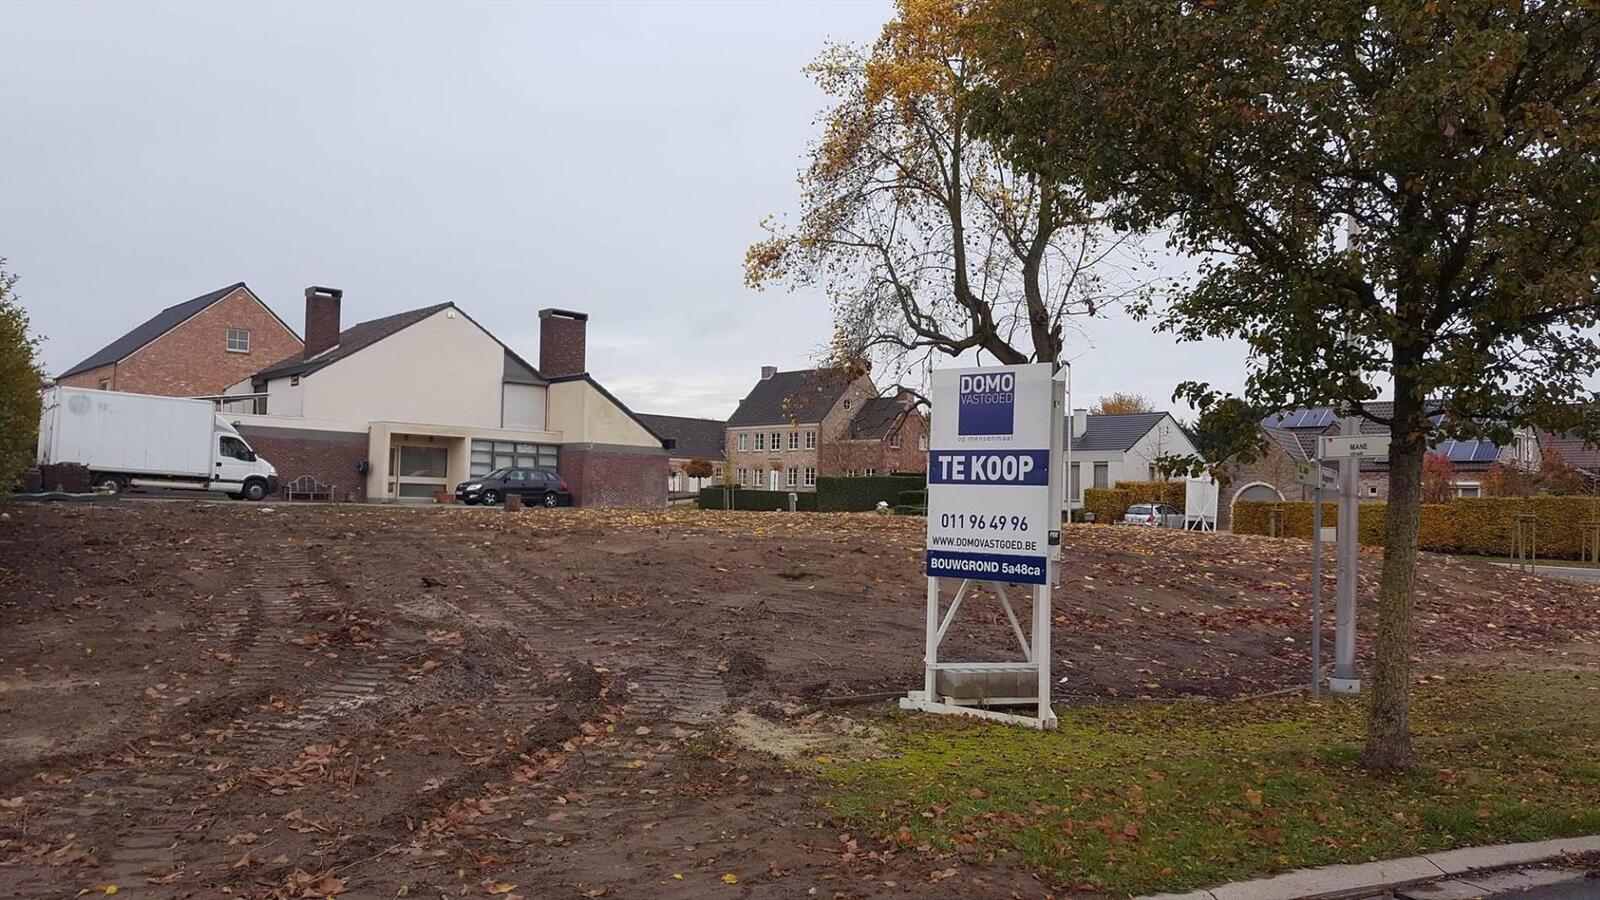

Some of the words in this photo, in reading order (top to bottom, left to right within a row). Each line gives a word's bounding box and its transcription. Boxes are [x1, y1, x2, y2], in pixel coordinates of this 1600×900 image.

[961, 374, 1013, 393] DOMO
[961, 393, 1013, 404] VASTGOED
[938, 455, 965, 481] TE
[971, 455, 1034, 481] KOOP
[941, 513, 964, 529] 011
[969, 514, 986, 530] 96
[989, 515, 1007, 531] 49
[1011, 516, 1028, 532] 96
[932, 536, 1037, 550] WWW.DOMOVASTGOED.BE
[930, 557, 999, 573] BOUWGROND
[1001, 562, 1040, 576] 5a48ca
